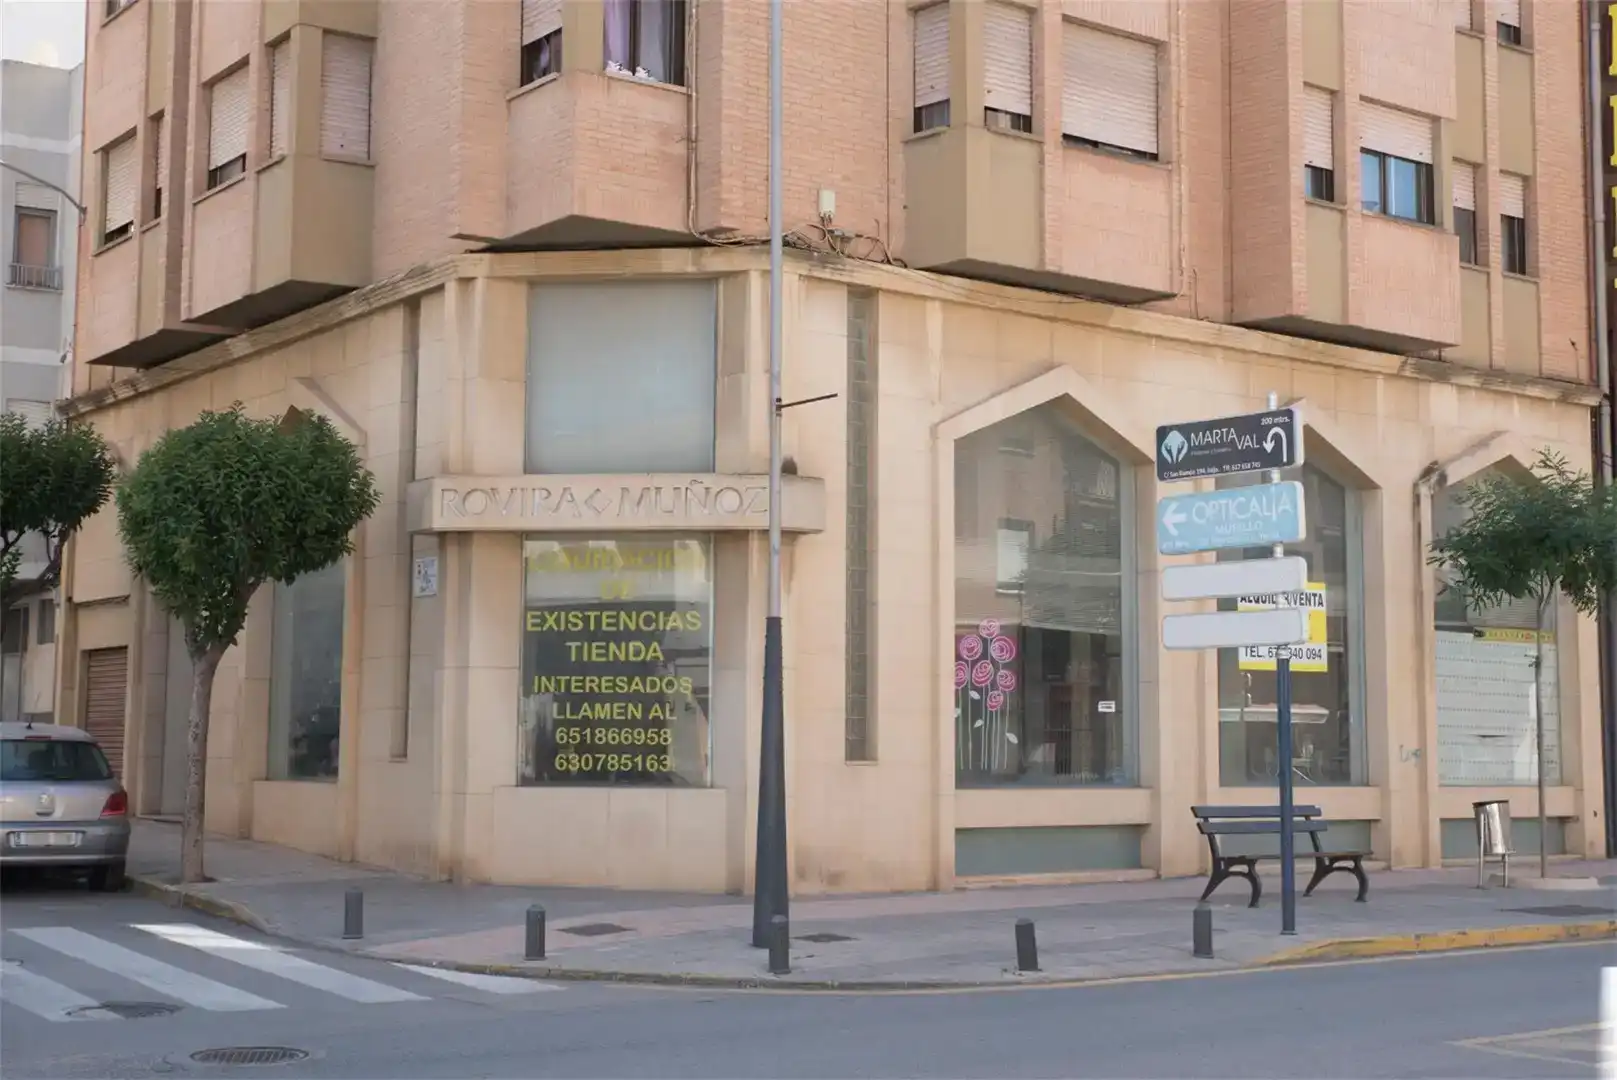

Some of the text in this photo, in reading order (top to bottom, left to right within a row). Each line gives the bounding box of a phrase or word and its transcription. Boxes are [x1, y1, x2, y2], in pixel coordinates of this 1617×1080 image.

[1190, 427, 1260, 450] MARTA VAL
[440, 479, 768, 518] ROVIRA MUÑOZ
[1192, 491, 1294, 525] OPTICALIA
[1240, 592, 1324, 608] ALQUILR/VENTA
[526, 611, 701, 632] EXISTENCIAS
[565, 641, 664, 662] TIENDA
[1244, 646, 1265, 658] TEL.
[1306, 648, 1322, 660] 094
[533, 675, 693, 694] INTERESADOS
[552, 702, 677, 720] LLAMEN AL
[555, 727, 672, 745] 651866958
[554, 753, 671, 772] 630785163
